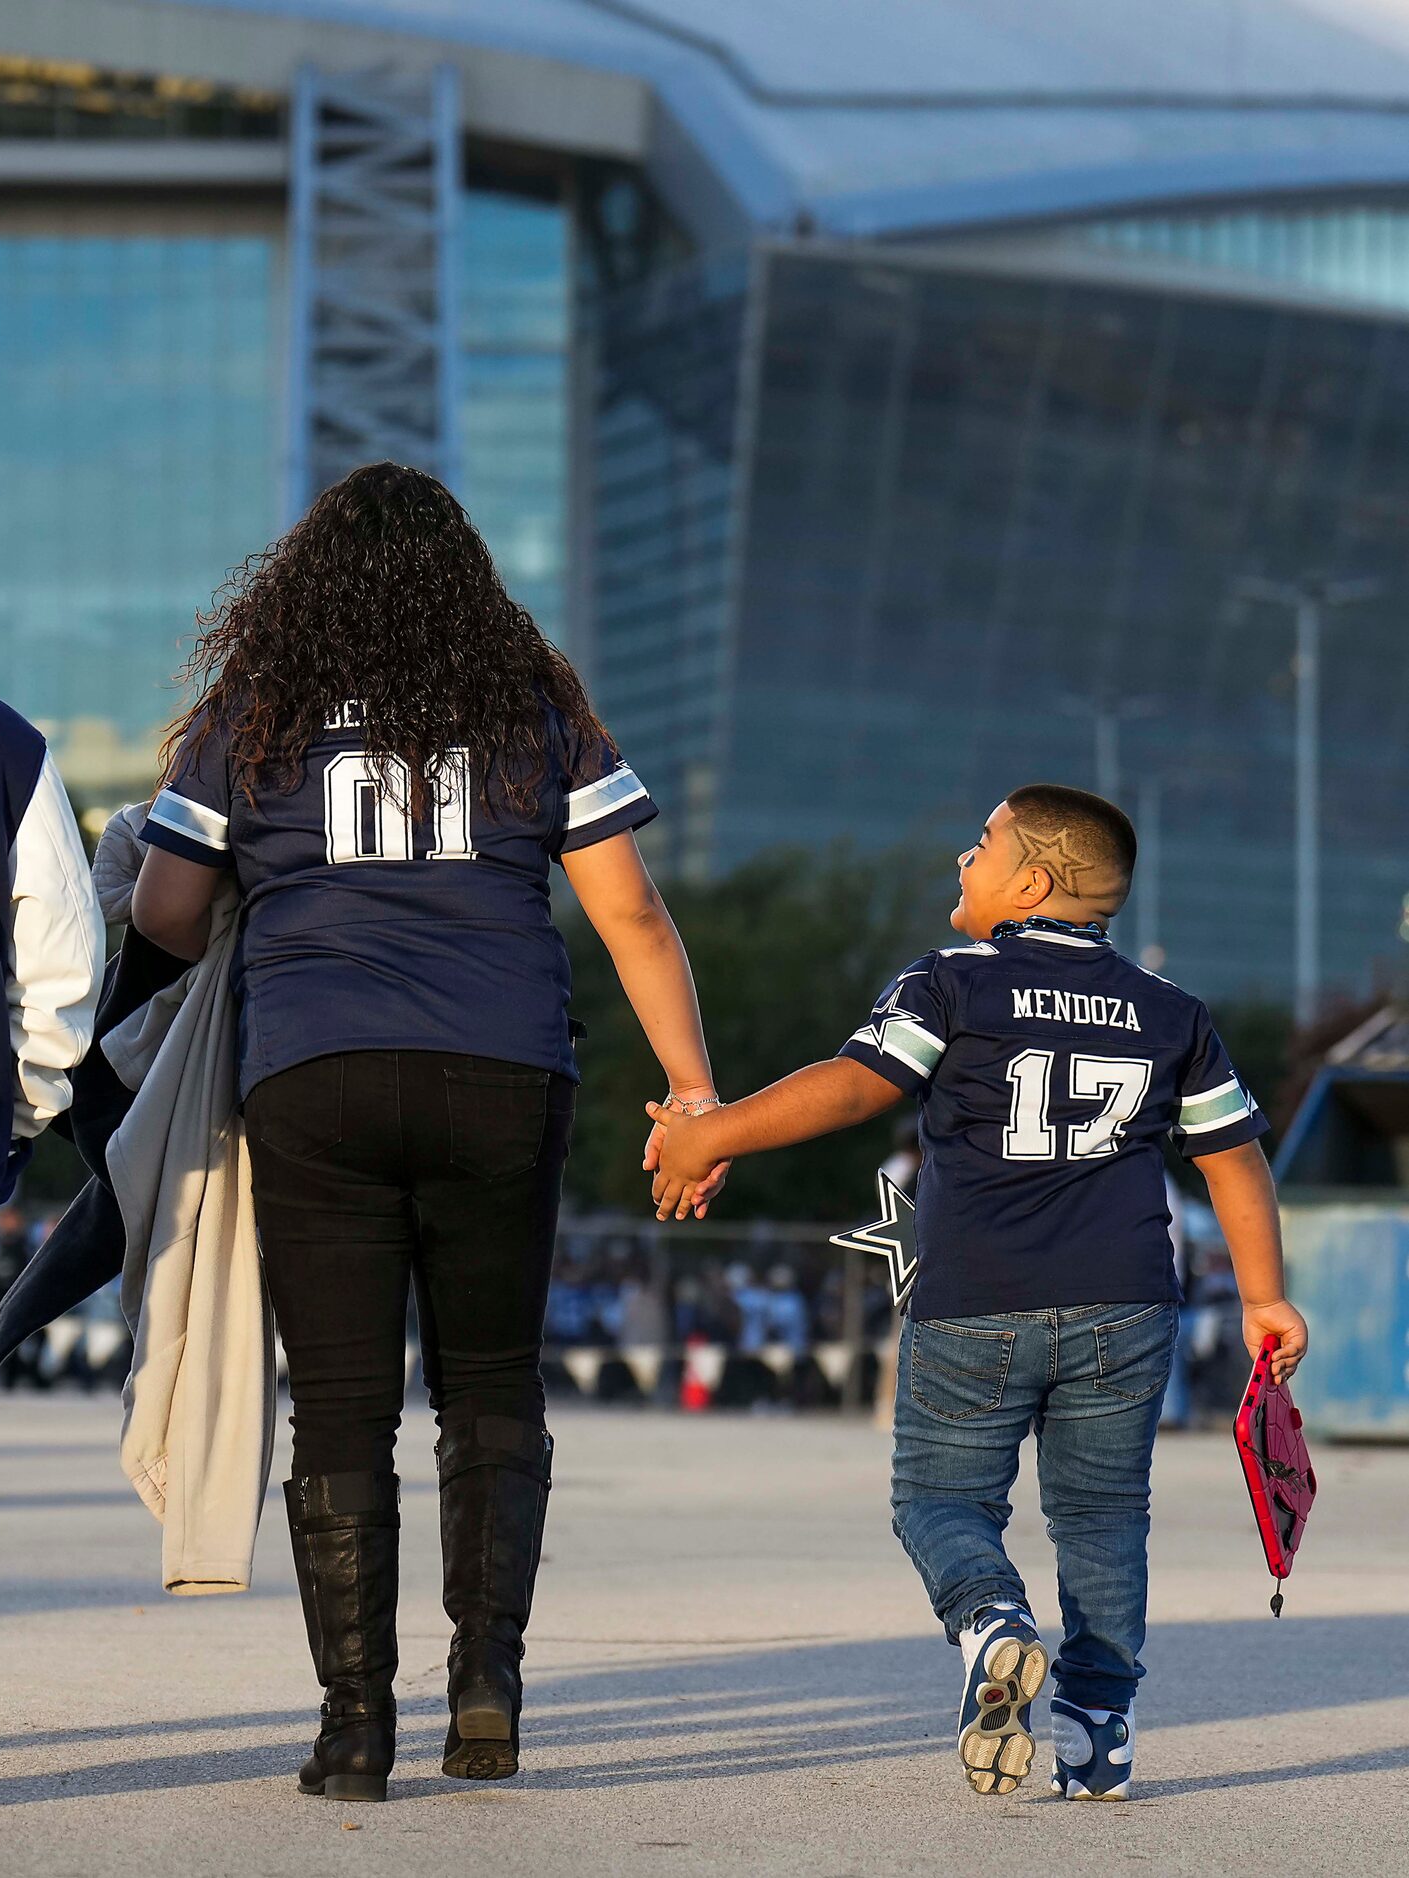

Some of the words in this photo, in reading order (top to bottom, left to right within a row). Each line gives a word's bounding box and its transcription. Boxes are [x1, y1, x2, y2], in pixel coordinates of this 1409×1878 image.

[323, 747, 479, 865] 01
[1011, 988, 1142, 1032] MENDOZA
[1002, 1048, 1153, 1161] 17
